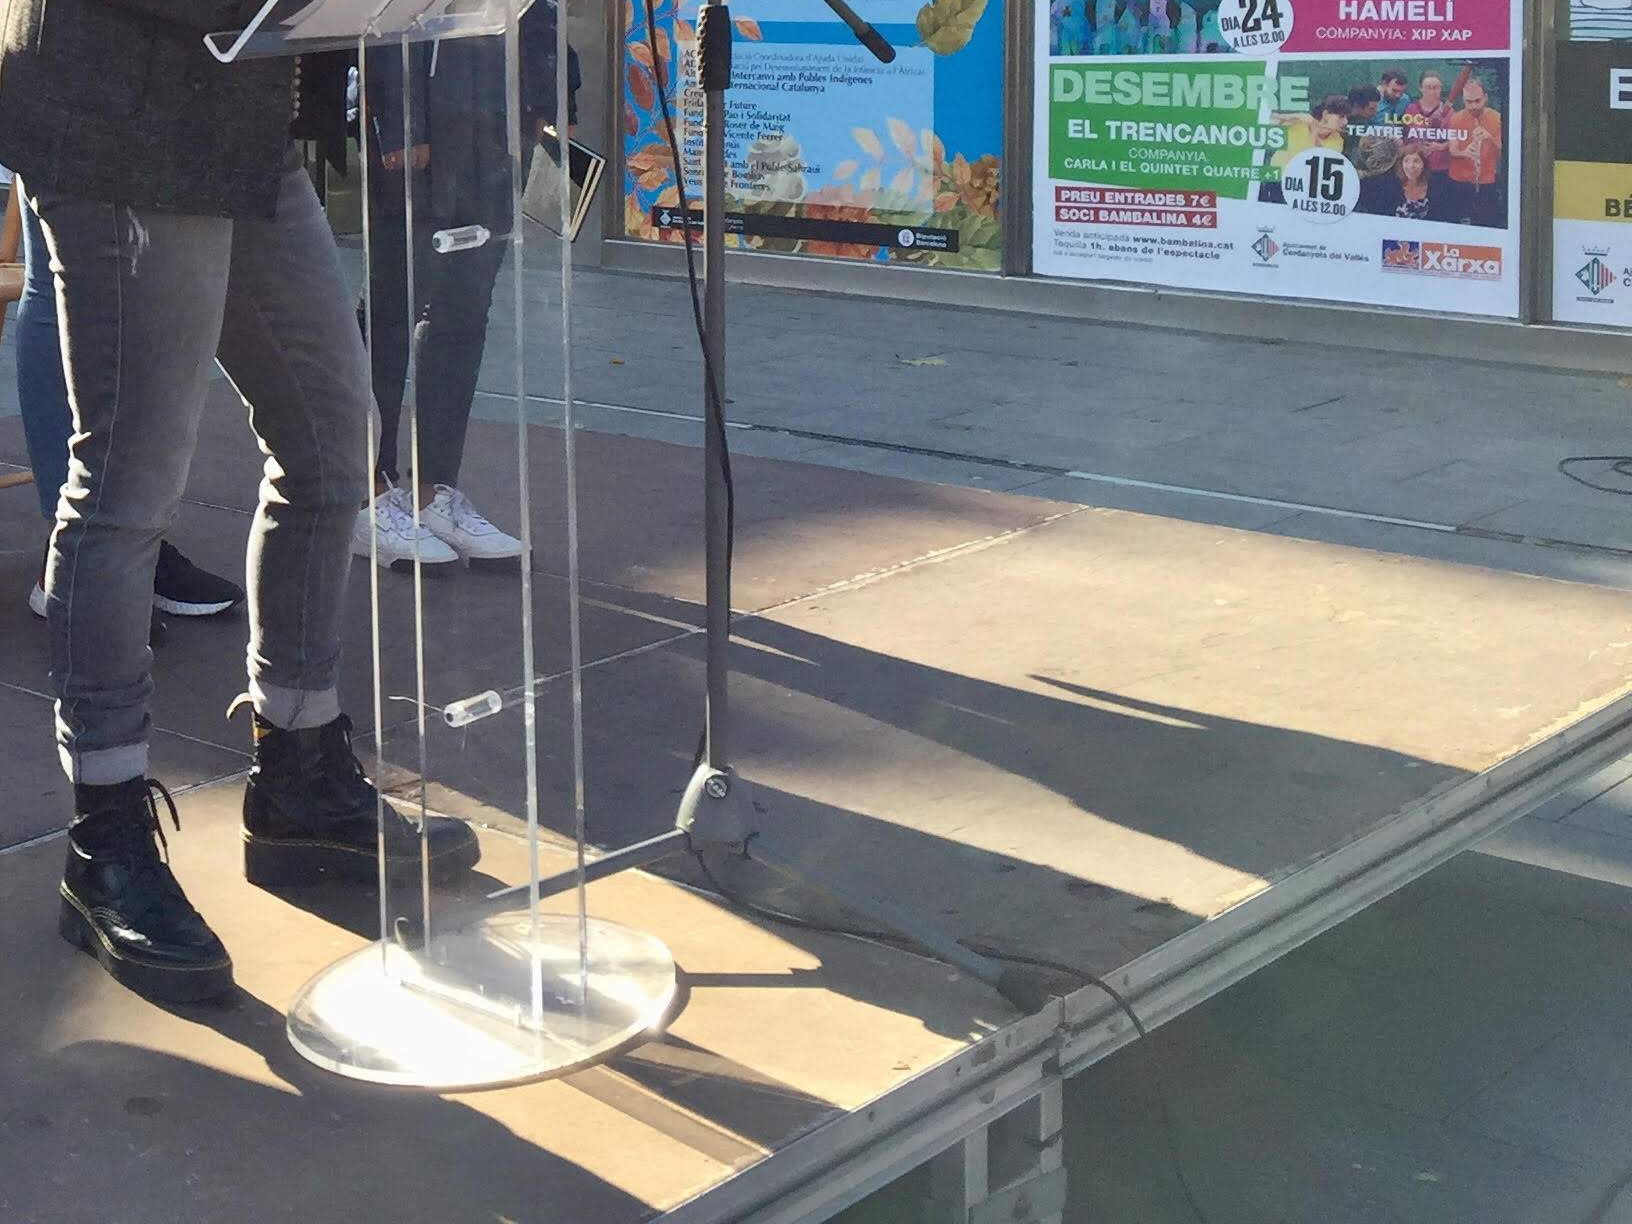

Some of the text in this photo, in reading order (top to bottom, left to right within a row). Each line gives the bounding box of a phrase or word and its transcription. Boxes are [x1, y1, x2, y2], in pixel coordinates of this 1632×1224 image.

[1221, 17, 1241, 31] DIA
[1260, 31, 1285, 44] 12.00
[1411, 30, 1436, 40] XIP
[1440, 30, 1473, 41] XAP
[1053, 69, 1310, 111] DESEMBRE
[1068, 119, 1284, 148] EL TRENCANOUS
[1347, 124, 1468, 141] TEATRE ATENEU
[1064, 157, 1108, 171] CARLA
[1120, 161, 1136, 172] EL
[1140, 162, 1199, 176] QUINTET
[1203, 165, 1260, 179] QUATRE
[1285, 155, 1344, 201] DIA 15
[1060, 190, 1100, 203] PREU
[1104, 191, 1185, 206] ENTRADES
[1059, 208, 1094, 222] SOCI
[1099, 209, 1187, 225] BAMBALINA
[1300, 201, 1318, 212] LES
[1320, 202, 1346, 216] 12.00
[1443, 244, 1460, 257] La
[1423, 249, 1501, 275] Xarxa
